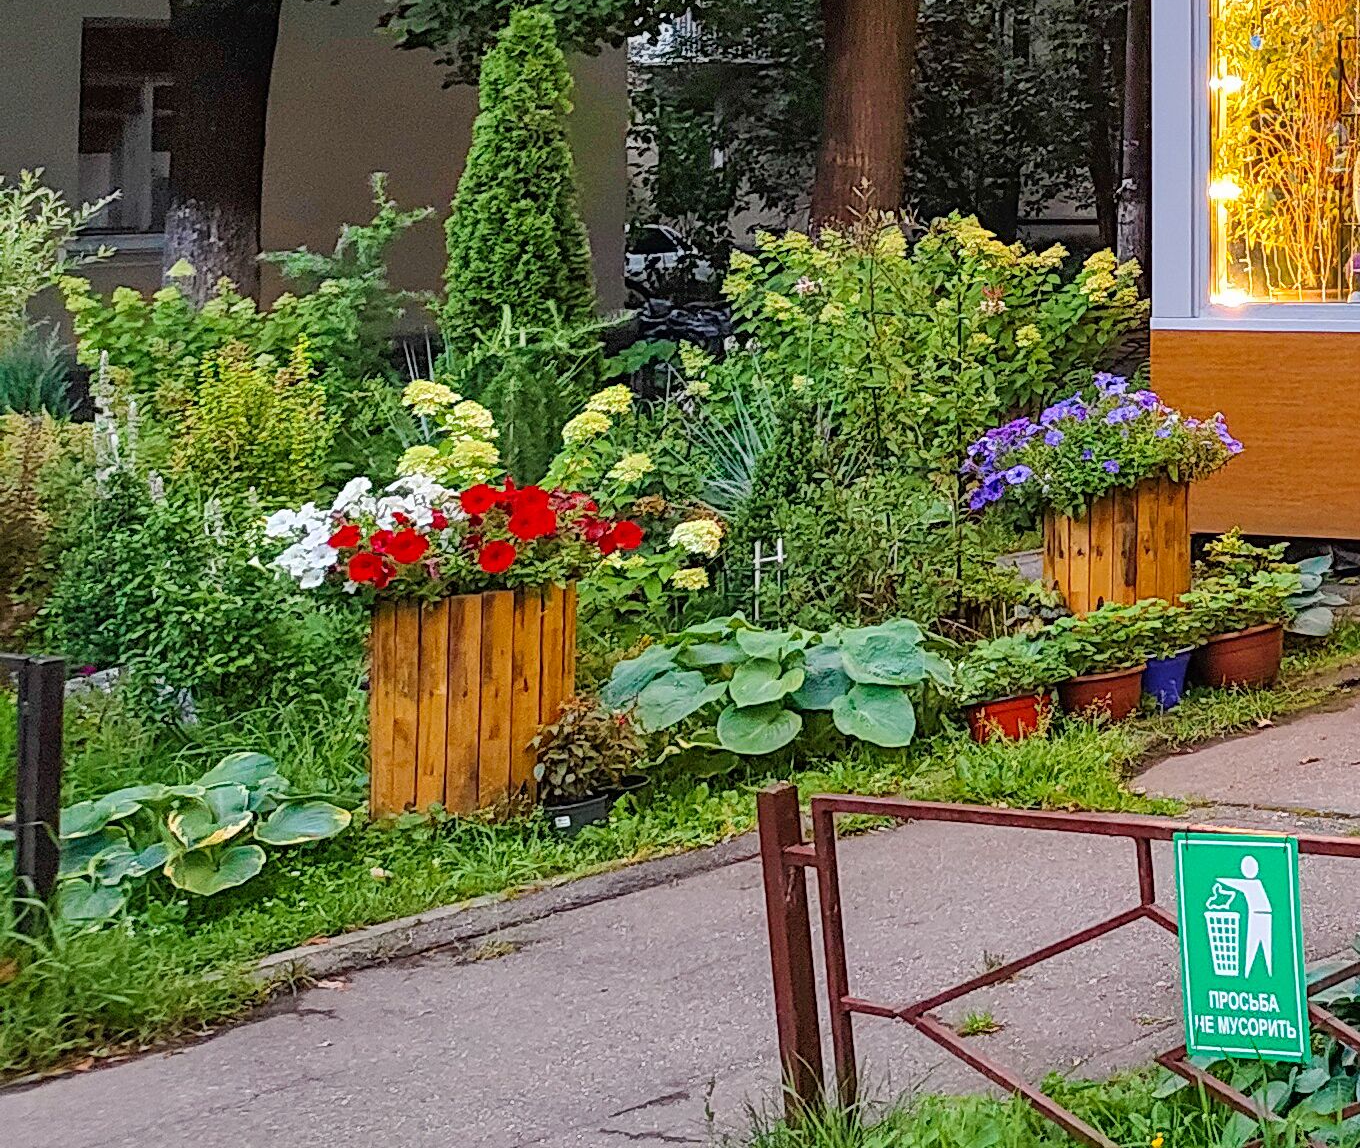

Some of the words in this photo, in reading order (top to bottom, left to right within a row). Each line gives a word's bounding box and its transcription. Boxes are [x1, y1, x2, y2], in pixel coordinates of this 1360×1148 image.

[1208, 990, 1280, 1013] ПРОСЬБА
[1194, 1015, 1215, 1034] НЕ
[1218, 1016, 1297, 1039] МУСОРИТЬ
